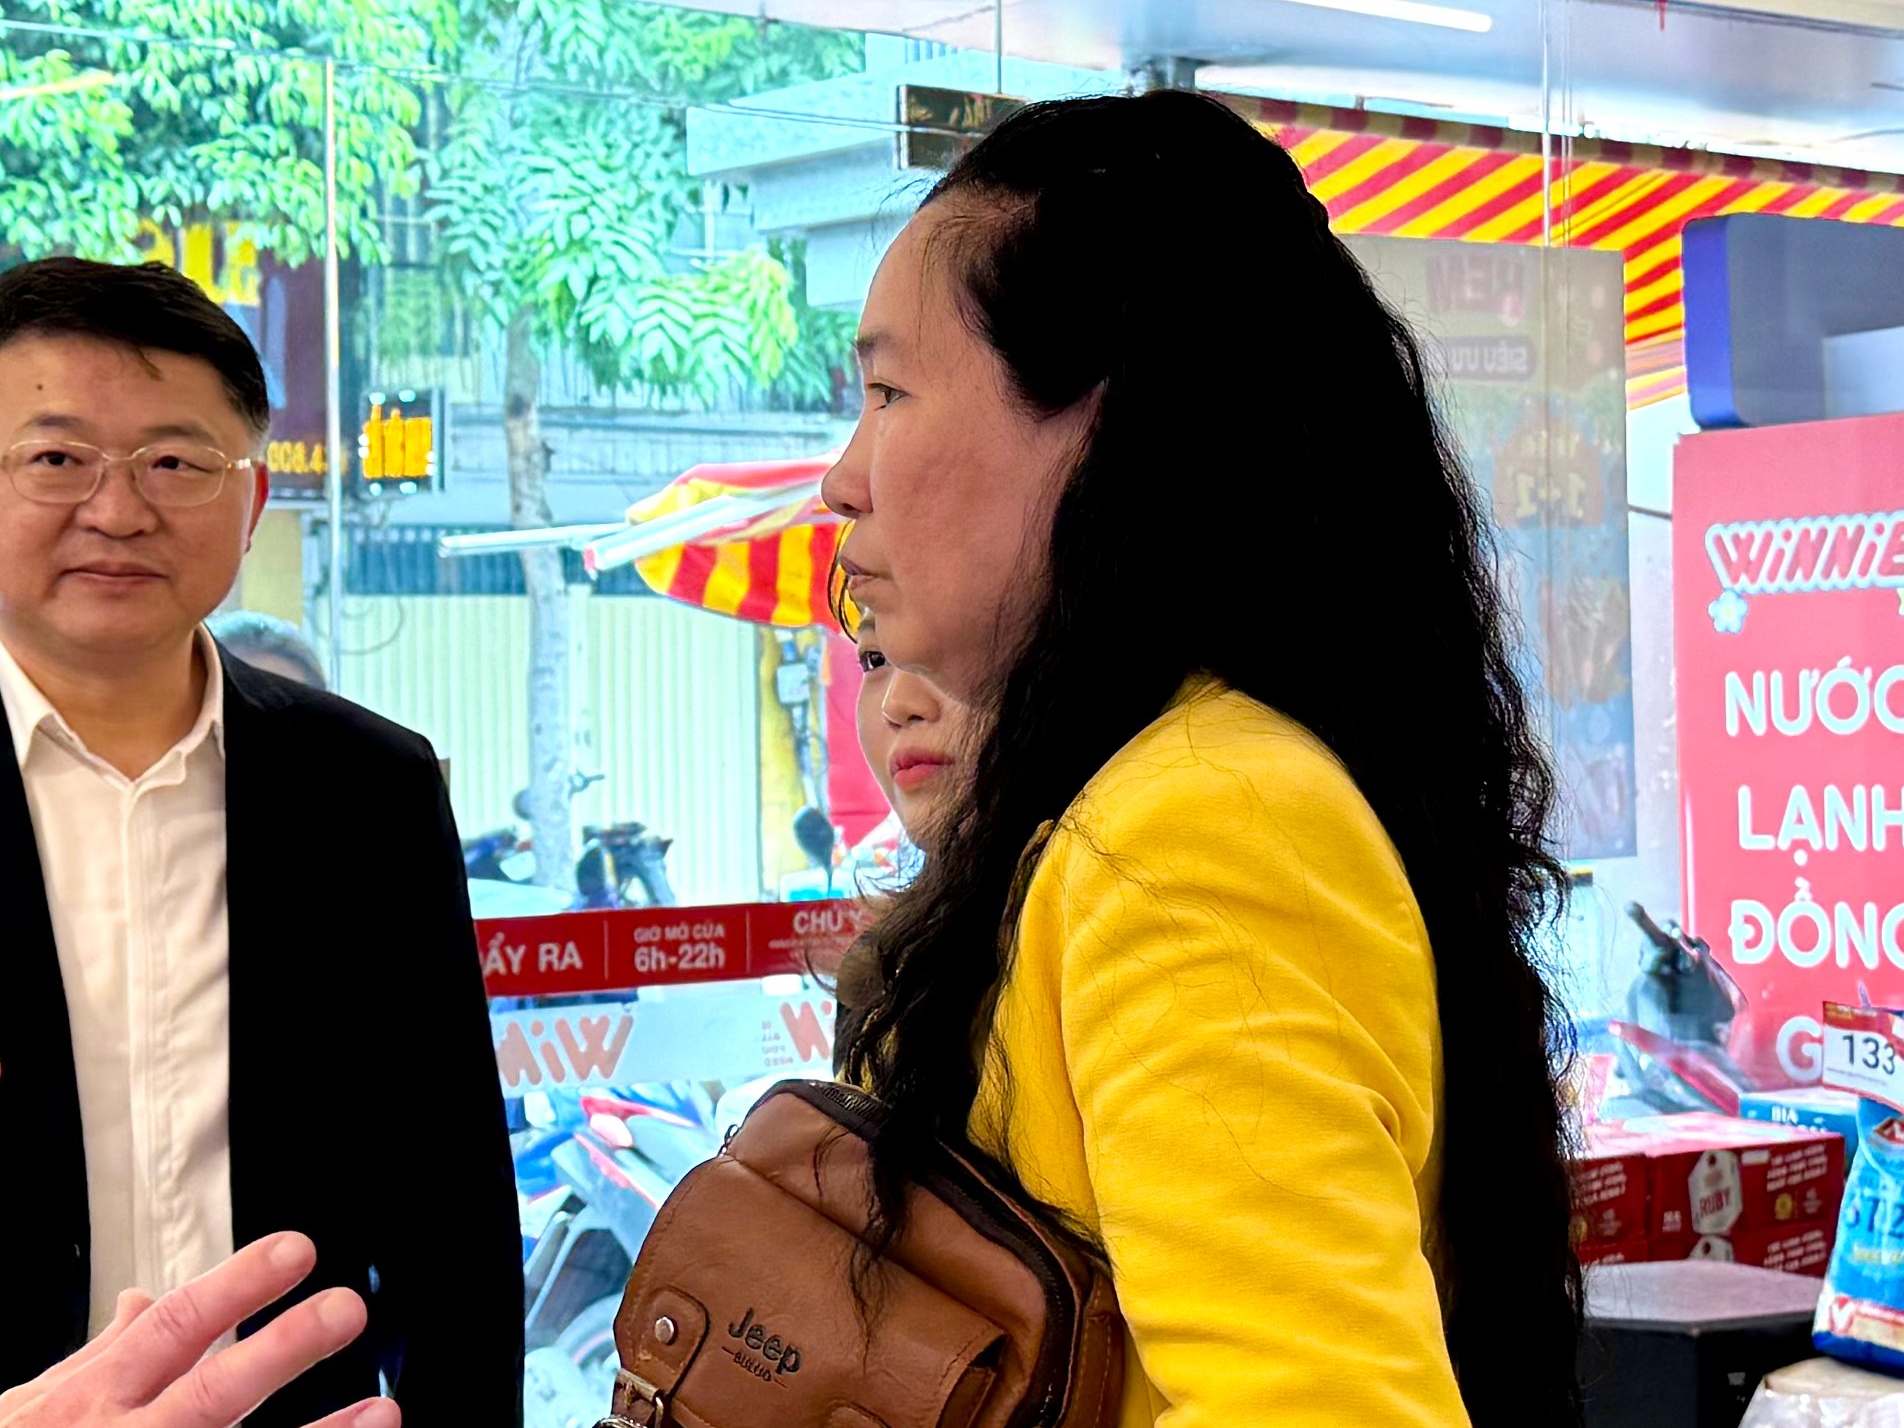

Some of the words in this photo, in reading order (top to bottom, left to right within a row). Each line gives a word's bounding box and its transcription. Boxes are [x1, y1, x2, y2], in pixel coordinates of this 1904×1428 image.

[538, 943, 583, 971] RA
[634, 943, 726, 973] 6h-22h
[1842, 1034, 1896, 1075] 133
[727, 1308, 802, 1375] Jeep
